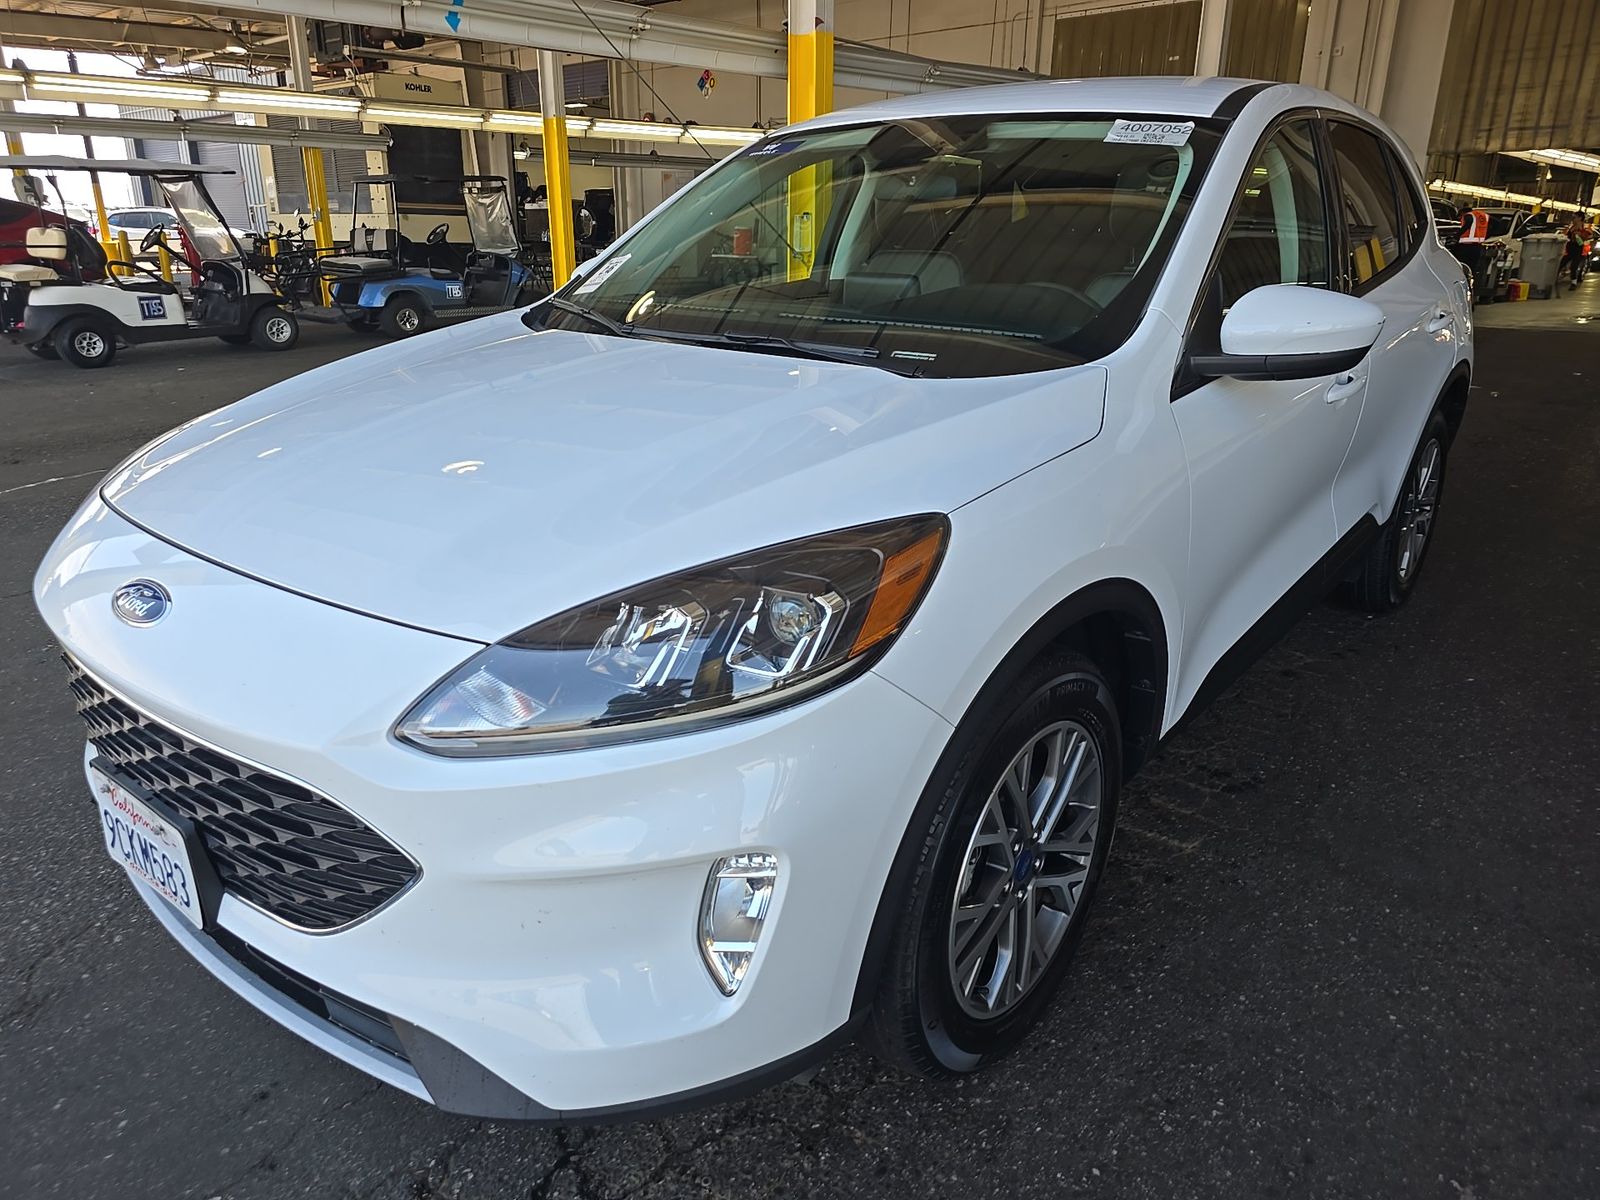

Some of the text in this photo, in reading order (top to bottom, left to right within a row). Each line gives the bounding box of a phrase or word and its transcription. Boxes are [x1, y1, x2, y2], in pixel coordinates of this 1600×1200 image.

[404, 82, 432, 94] KOHLER
[1120, 123, 1193, 135] 4007052
[117, 585, 158, 617] Ford
[103, 808, 191, 908] 9CKM583
